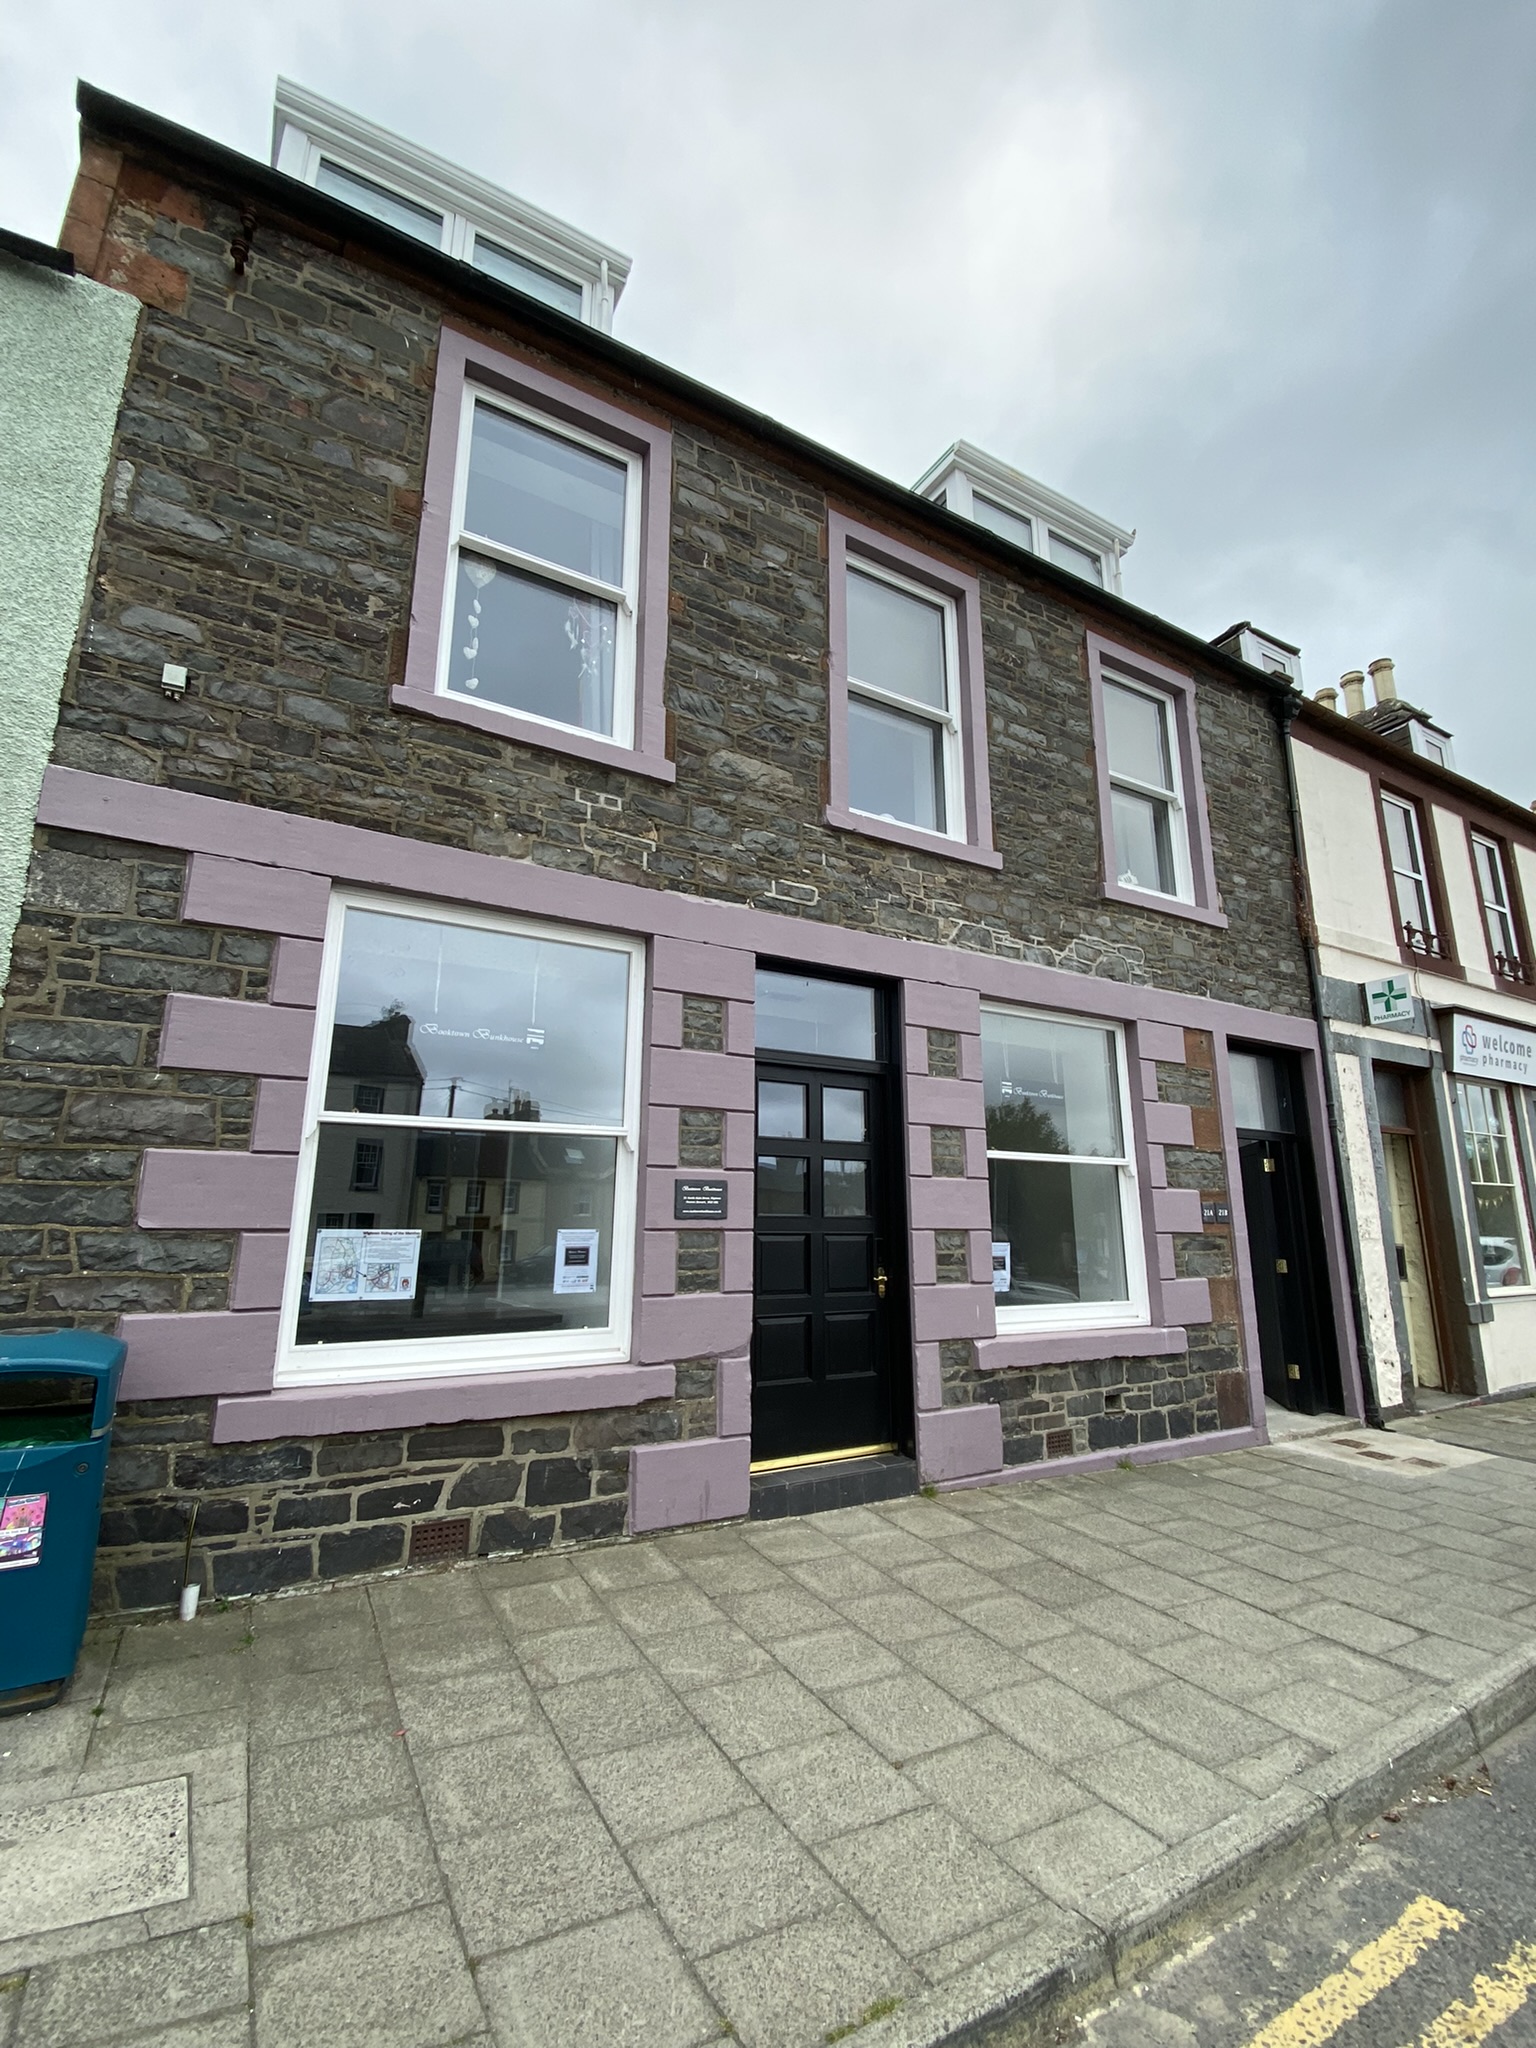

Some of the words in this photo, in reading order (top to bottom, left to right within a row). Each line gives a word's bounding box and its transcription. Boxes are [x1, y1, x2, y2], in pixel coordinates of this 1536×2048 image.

[1374, 1011, 1410, 1021] PHARMACY
[419, 1023, 470, 1038] Booktown
[472, 1028, 524, 1043] Bunkhouse
[1482, 1034, 1532, 1058] welcome
[1482, 1053, 1528, 1075] pharmacy
